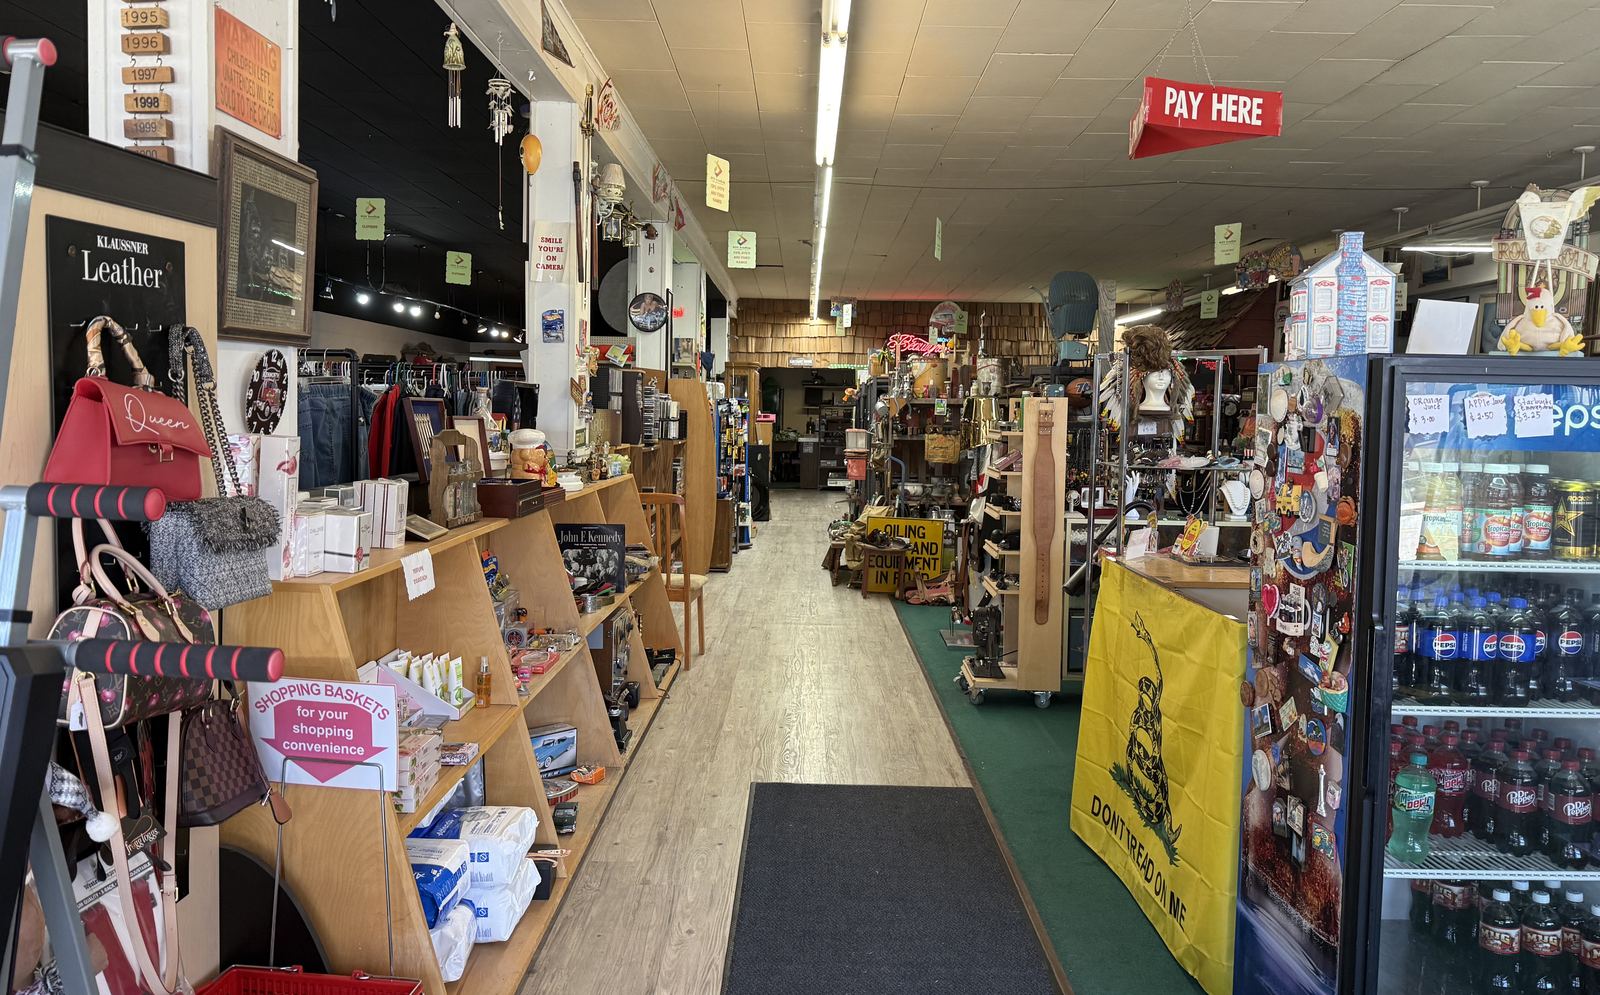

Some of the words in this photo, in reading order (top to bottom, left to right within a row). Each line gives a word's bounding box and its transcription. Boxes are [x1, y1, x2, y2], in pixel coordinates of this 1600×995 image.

[124, 11, 158, 24] 1995
[125, 36, 158, 49] 1996
[220, 12, 277, 72] WARNING
[227, 47, 256, 77] CHILDREN
[257, 64, 270, 86] LEFT
[131, 69, 157, 81] 1997
[221, 82, 235, 112] SOLD
[236, 91, 245, 117] TO
[256, 84, 267, 104] WILL
[133, 97, 160, 109] 1998
[1164, 87, 1203, 120] PAY
[1211, 93, 1263, 126] HERE
[134, 122, 157, 133] 1999
[96, 235, 149, 255] KLAUSSNER
[540, 236, 562, 244] SMILE
[81, 249, 163, 288] Leather
[271, 350, 278, 362] 12
[252, 369, 260, 382] 10
[282, 373, 288, 384] 2
[247, 389, 254, 400] 9
[282, 390, 287, 401] 3
[124, 393, 190, 435] Queen
[247, 406, 252, 417] 8
[1477, 411, 1494, 420] 2.50
[252, 421, 257, 433] 7
[269, 421, 274, 432] 5
[558, 530, 579, 544] John
[588, 530, 623, 545] Kennedy
[884, 524, 926, 539] OILING
[911, 541, 939, 556] AND
[875, 570, 889, 585] IN
[1500, 642, 1525, 651] PEPSI
[1560, 638, 1583, 646] PEPSI
[255, 683, 321, 713] SHOPPING
[324, 684, 390, 720] BASKETS
[296, 706, 315, 718] for
[318, 709, 348, 721] your
[292, 723, 354, 740] shopping
[282, 740, 365, 755] convenience
[1510, 793, 1535, 806] Pepper
[1518, 790, 1530, 799] Dr
[1567, 804, 1592, 817] Pepper
[1576, 801, 1587, 809] Dr
[1126, 827, 1155, 884] TREAD
[1154, 871, 1168, 909] ON
[1169, 890, 1187, 932] ME
[1481, 927, 1511, 945] MUG
[1526, 932, 1558, 945] MUG
